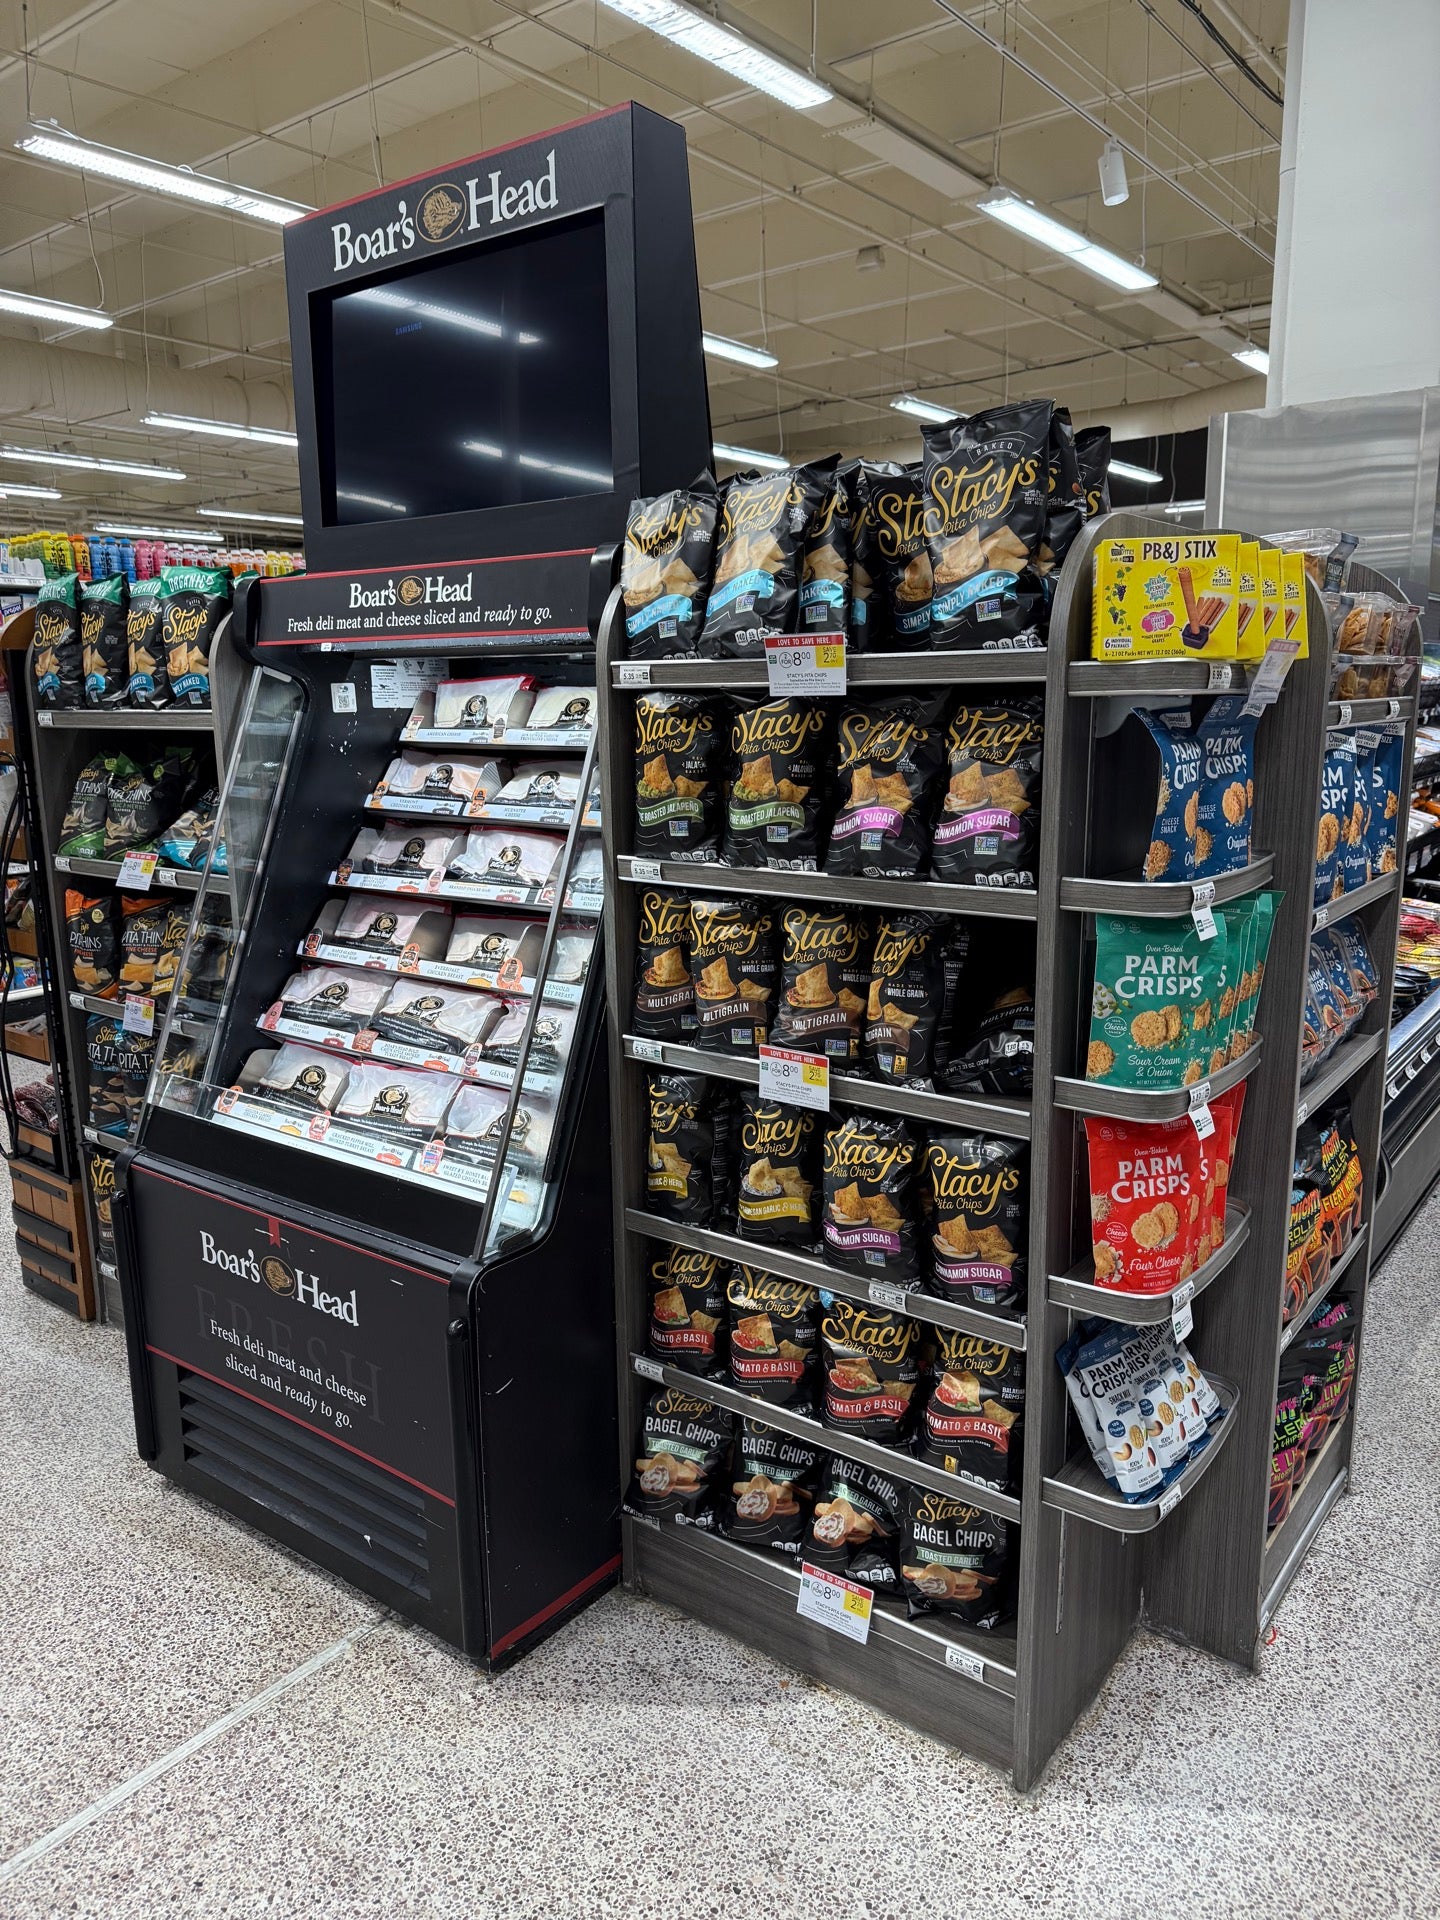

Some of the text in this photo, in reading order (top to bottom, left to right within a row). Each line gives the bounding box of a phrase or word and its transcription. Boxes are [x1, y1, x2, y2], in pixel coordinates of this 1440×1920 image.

[331, 149, 558, 272] Boar's Head
[976, 442, 1013, 456] BAKED
[924, 457, 1040, 537] Stacy's
[717, 481, 806, 550] Stacy's
[945, 501, 997, 536] Pita Chips
[622, 503, 703, 569] Stacy's
[1143, 541, 1180, 563] PB&J
[1185, 540, 1217, 559] STIX
[169, 574, 206, 591] ORGANIC
[349, 572, 472, 608] Boar's Head
[4, 604, 22, 617] propel
[937, 591, 966, 615] SIMPLY
[163, 607, 208, 643] Stacy's
[288, 604, 552, 632] Fresh deli meat and cheese sliced and ready to go.
[902, 610, 931, 630] SIMPLY
[1105, 639, 1110, 648] 6
[636, 697, 713, 754] Stacy's
[732, 701, 826, 755] Stacy's
[945, 706, 1044, 764] Stacy's
[657, 738, 681, 752] Chips
[762, 738, 790, 753] Chips
[973, 748, 1003, 760] Chips
[1205, 735, 1243, 756] PARM
[1205, 753, 1247, 780] CRISPS
[667, 800, 699, 814] JALAPEÑO
[765, 805, 799, 820] JALAPEÑO
[863, 812, 895, 827] SUGAR
[934, 815, 1010, 840] CINNAMON SUGAR
[1161, 817, 1180, 826] CHEESE
[1160, 825, 1178, 834] SNACK
[717, 941, 743, 954] Chips
[794, 947, 847, 964] Pita Chips
[741, 964, 760, 973] WHOLE
[1125, 955, 1199, 974] PARM
[887, 988, 925, 998] WHOLE GRAIN
[1115, 976, 1204, 999] CRISPS
[647, 990, 694, 1008] MULTIGRAI
[1104, 1021, 1127, 1032] Cheese
[635, 1047, 648, 1055] 5.35
[1127, 1054, 1181, 1065] Sour Cream
[1136, 1066, 1174, 1077] & Onion
[823, 1124, 914, 1183] Stacy's
[850, 1165, 875, 1178] Chips
[1118, 1154, 1183, 1180] PARM
[928, 1145, 1020, 1215] Stacy's
[1111, 1173, 1190, 1203] CRISPS
[956, 1198, 982, 1214] Chips
[862, 1232, 891, 1245] SUGAR
[1105, 1228, 1128, 1238] Cheese
[1129, 1256, 1181, 1271] Four Cheese
[200, 1230, 359, 1327] Boar's Head
[970, 1267, 1003, 1279] SUGAR
[872, 1290, 886, 1301] 5.35
[765, 1300, 791, 1313] Chips
[683, 1333, 709, 1345] BASIL
[821, 1301, 921, 1363] Stacy's
[844, 1340, 893, 1359] Pita Chips
[210, 1319, 367, 1407] Fresh deli meat and cheese
[771, 1362, 798, 1373] BASIL
[1089, 1358, 1125, 1382] PARM
[225, 1354, 353, 1429] sliced and ready to go.
[873, 1400, 903, 1413] BASIL
[645, 1416, 721, 1449] BAGEL CHIPS
[926, 1412, 1002, 1440] TOMATO BASIL
[652, 1440, 679, 1453] TOASTED
[741, 1437, 816, 1466] BAGEL CHIPS
[747, 1462, 800, 1479] TOASTED GARLIC
[831, 1458, 899, 1508] BAGEL CHIPS
[858, 1495, 883, 1516] GARLIC
[913, 1522, 995, 1549] BAGEL CHIPS
[920, 1549, 979, 1567] TOASTED GARLIC
